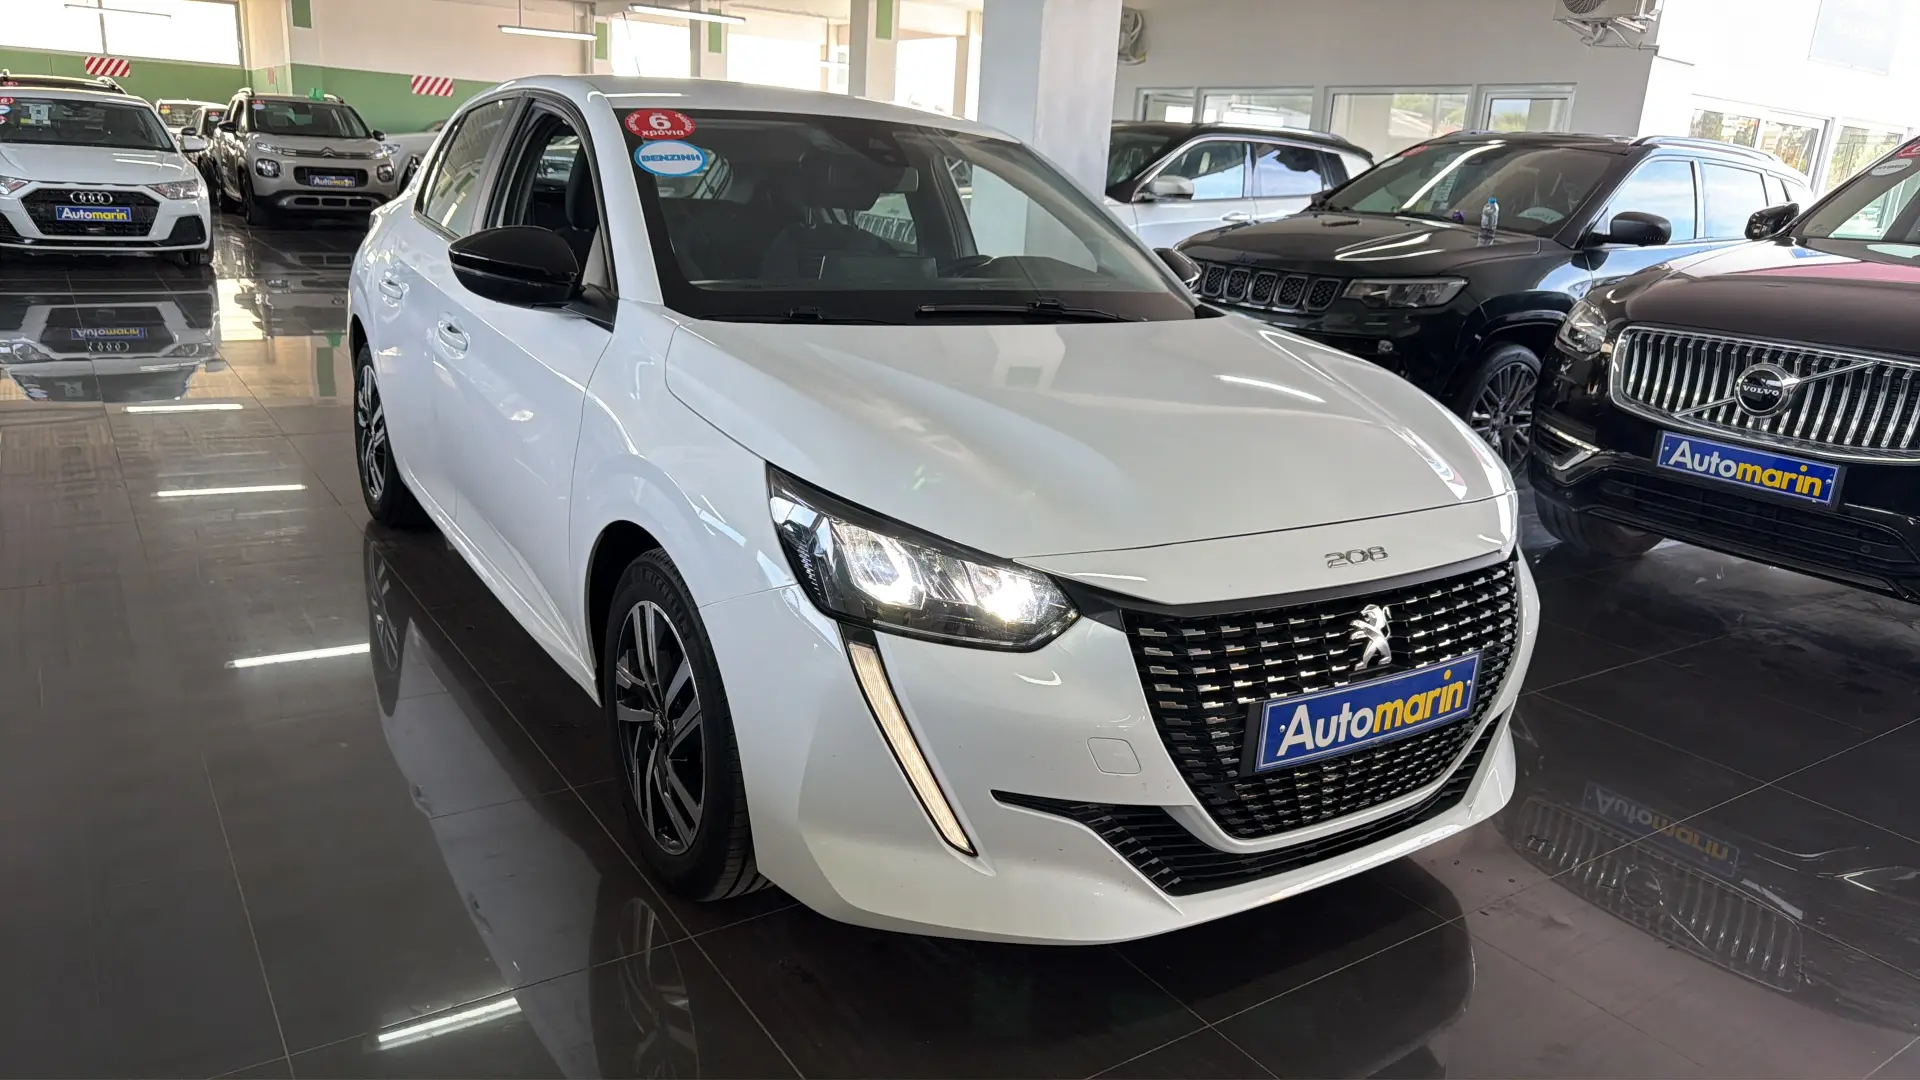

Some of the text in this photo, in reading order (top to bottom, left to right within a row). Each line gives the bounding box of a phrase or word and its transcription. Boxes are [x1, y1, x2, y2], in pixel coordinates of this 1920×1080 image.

[649, 114, 671, 130] 6
[61, 207, 127, 220] Automarin
[1742, 385, 1780, 397] VOLVO
[1668, 440, 1823, 497] Automarin
[1324, 546, 1389, 569] 208
[1276, 669, 1464, 757] Automarin
